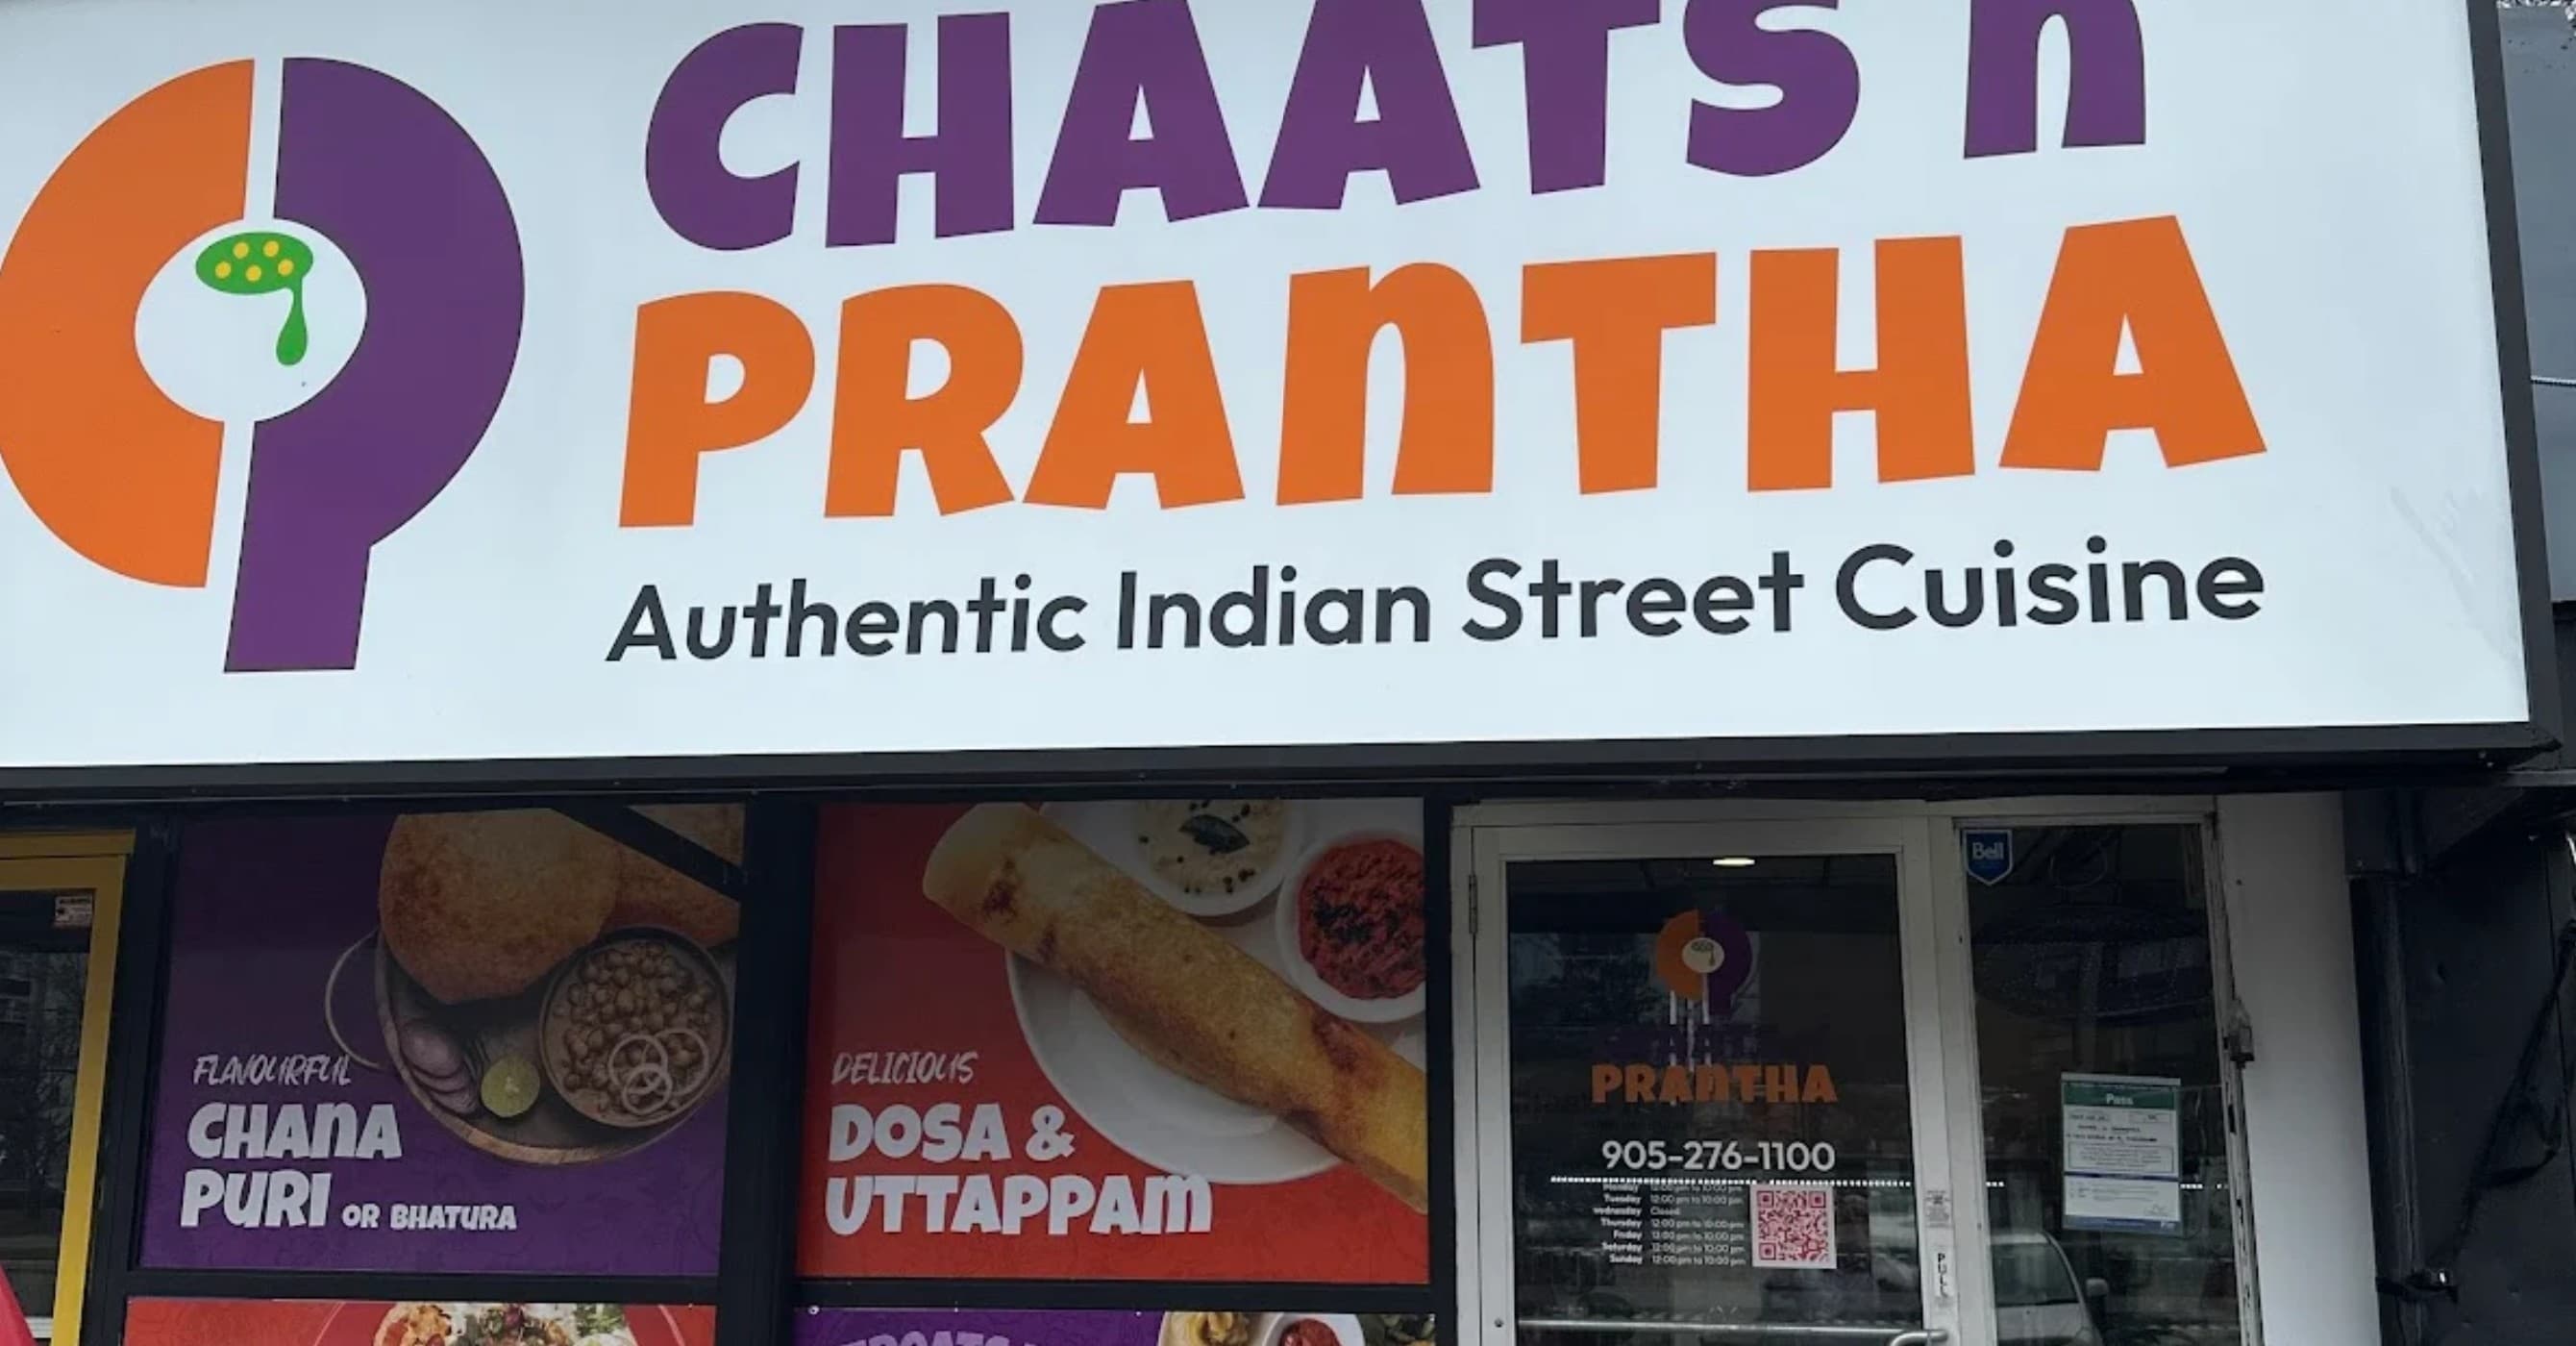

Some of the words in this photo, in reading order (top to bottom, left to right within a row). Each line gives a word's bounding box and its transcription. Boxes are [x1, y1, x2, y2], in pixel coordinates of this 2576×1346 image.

[645, 0, 1861, 252] CHAATS
[604, 573, 1089, 663] Authentic
[1116, 563, 1431, 652] Indian
[1461, 550, 1806, 643] Street
[1835, 536, 2266, 633] Cuisine
[1972, 841, 2004, 860] Bell
[193, 1054, 352, 1086] FLAVOURFUL
[831, 1051, 978, 1085] DELICIOUS
[828, 1102, 1013, 1163] DOSA
[1025, 1104, 1076, 1162] &
[1601, 1139, 1836, 1171] 905-276-1100
[180, 1167, 333, 1230] PURI
[341, 1202, 382, 1230] OR
[389, 1202, 518, 1232] BHATURA
[825, 1172, 1213, 1237] UTTAPPAM
